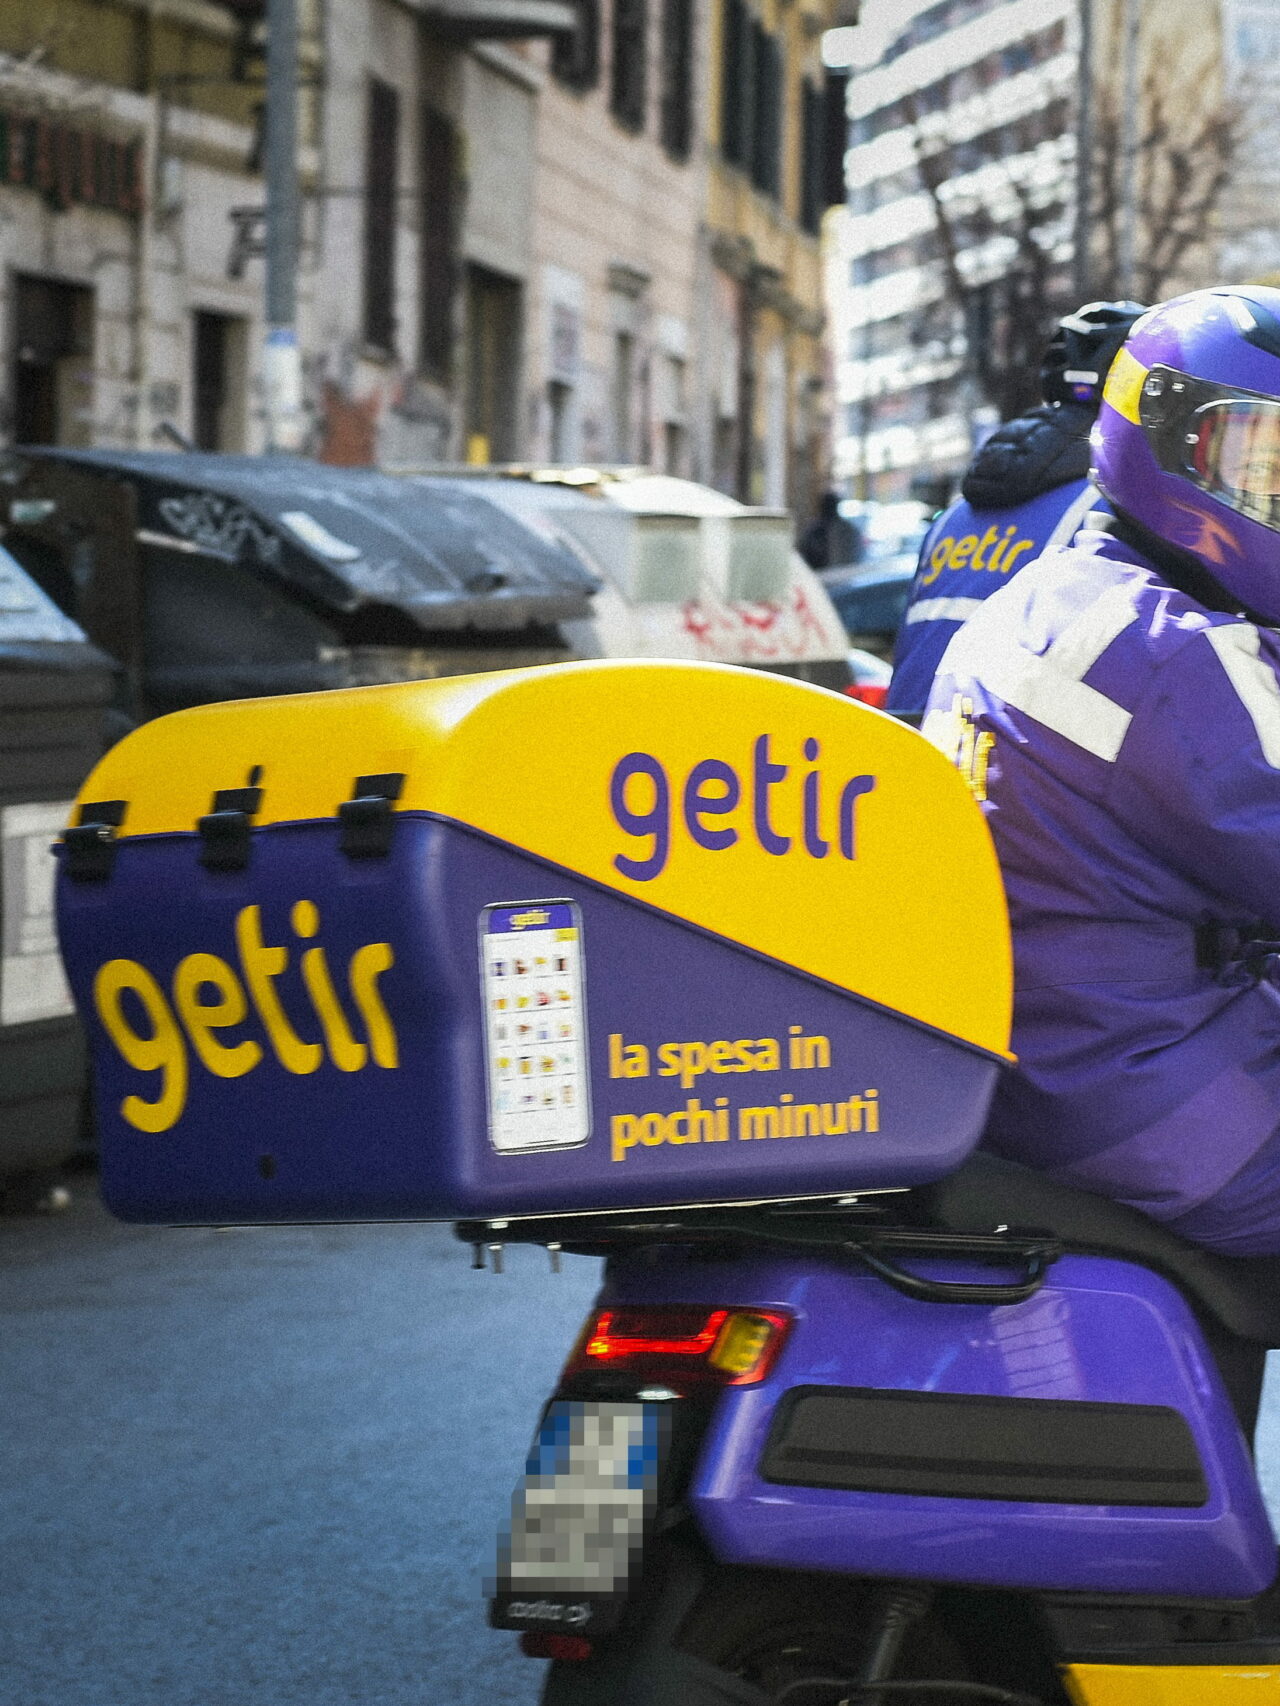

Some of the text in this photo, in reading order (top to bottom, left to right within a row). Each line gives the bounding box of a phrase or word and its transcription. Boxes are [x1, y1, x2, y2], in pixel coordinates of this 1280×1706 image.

[923, 525, 1034, 586] getir
[610, 734, 877, 882] getir
[94, 899, 399, 1133] getir
[608, 1025, 831, 1089] la spesa in
[611, 1088, 880, 1162] pochi minuti
